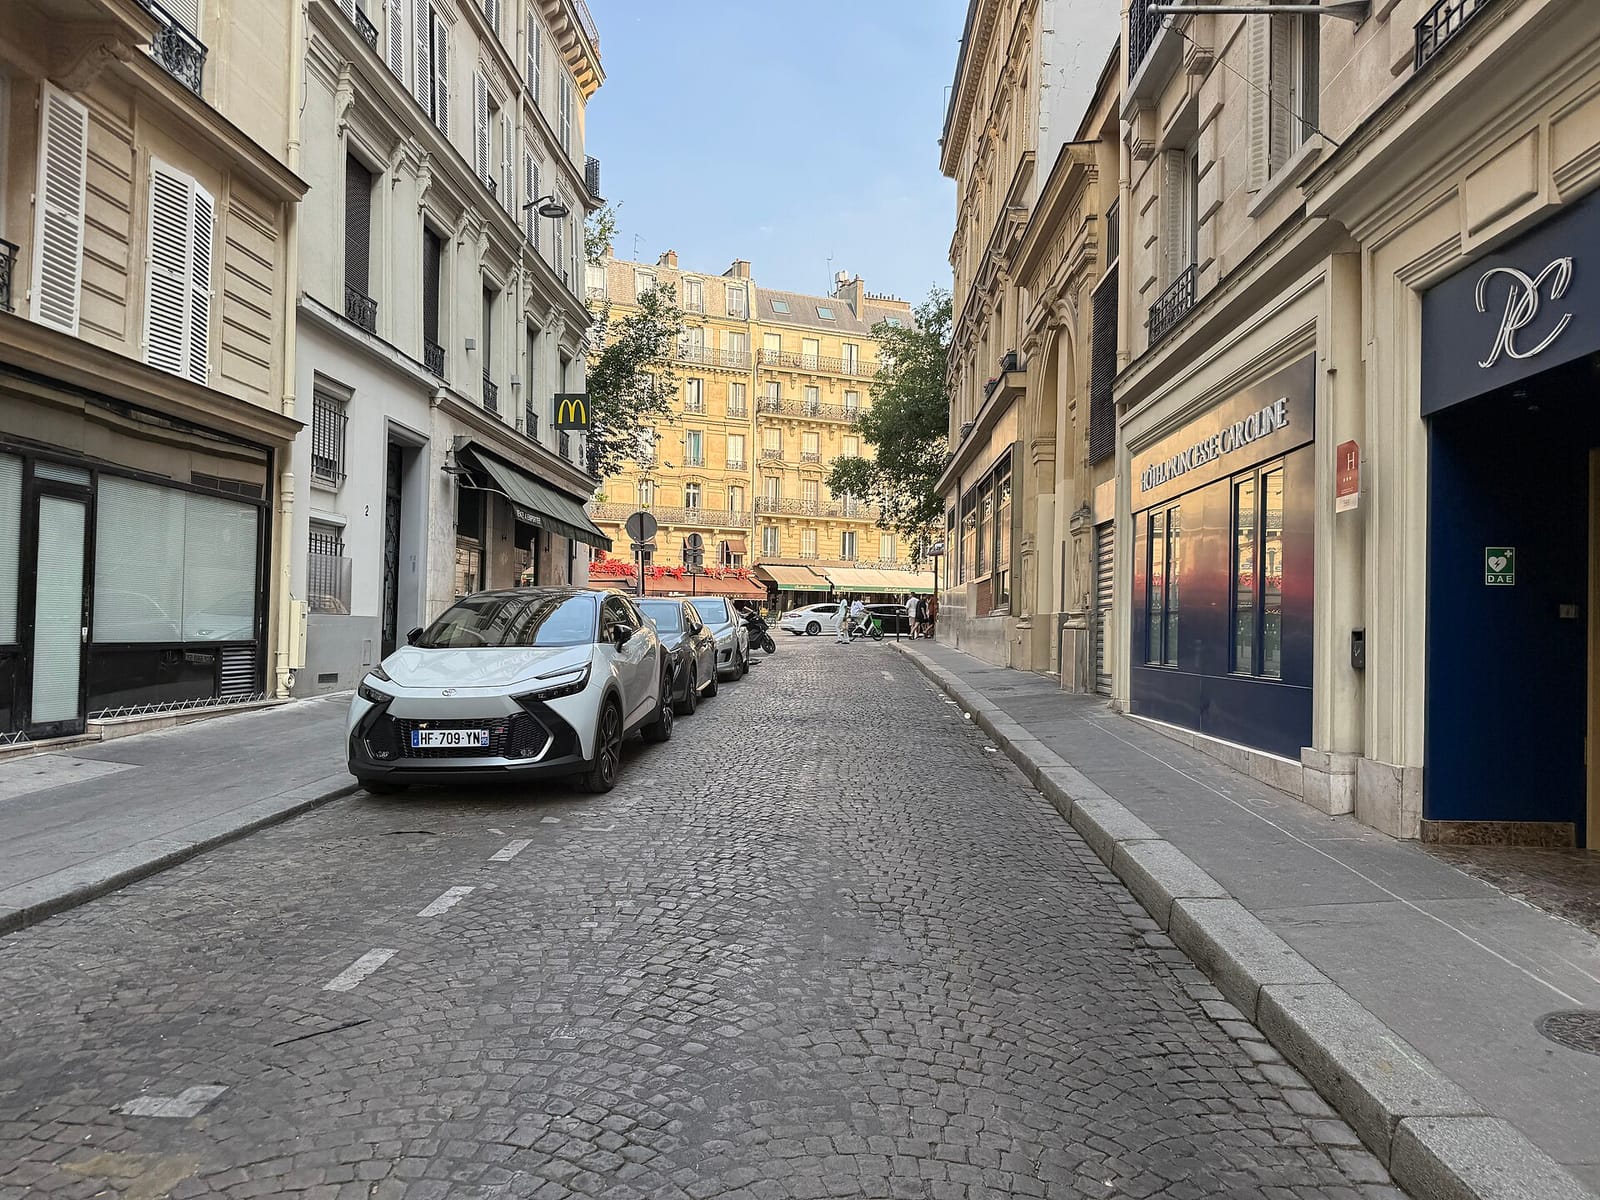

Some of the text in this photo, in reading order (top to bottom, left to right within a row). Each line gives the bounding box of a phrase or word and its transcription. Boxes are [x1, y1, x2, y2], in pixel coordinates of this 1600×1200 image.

[1166, 435, 1219, 481] PRINCESSE
[1218, 397, 1289, 455] CAROLINE
[1347, 451, 1355, 471] H
[364, 504, 370, 517] 2
[1487, 575, 1513, 583] DAE
[420, 731, 480, 745] HF-709-YN
